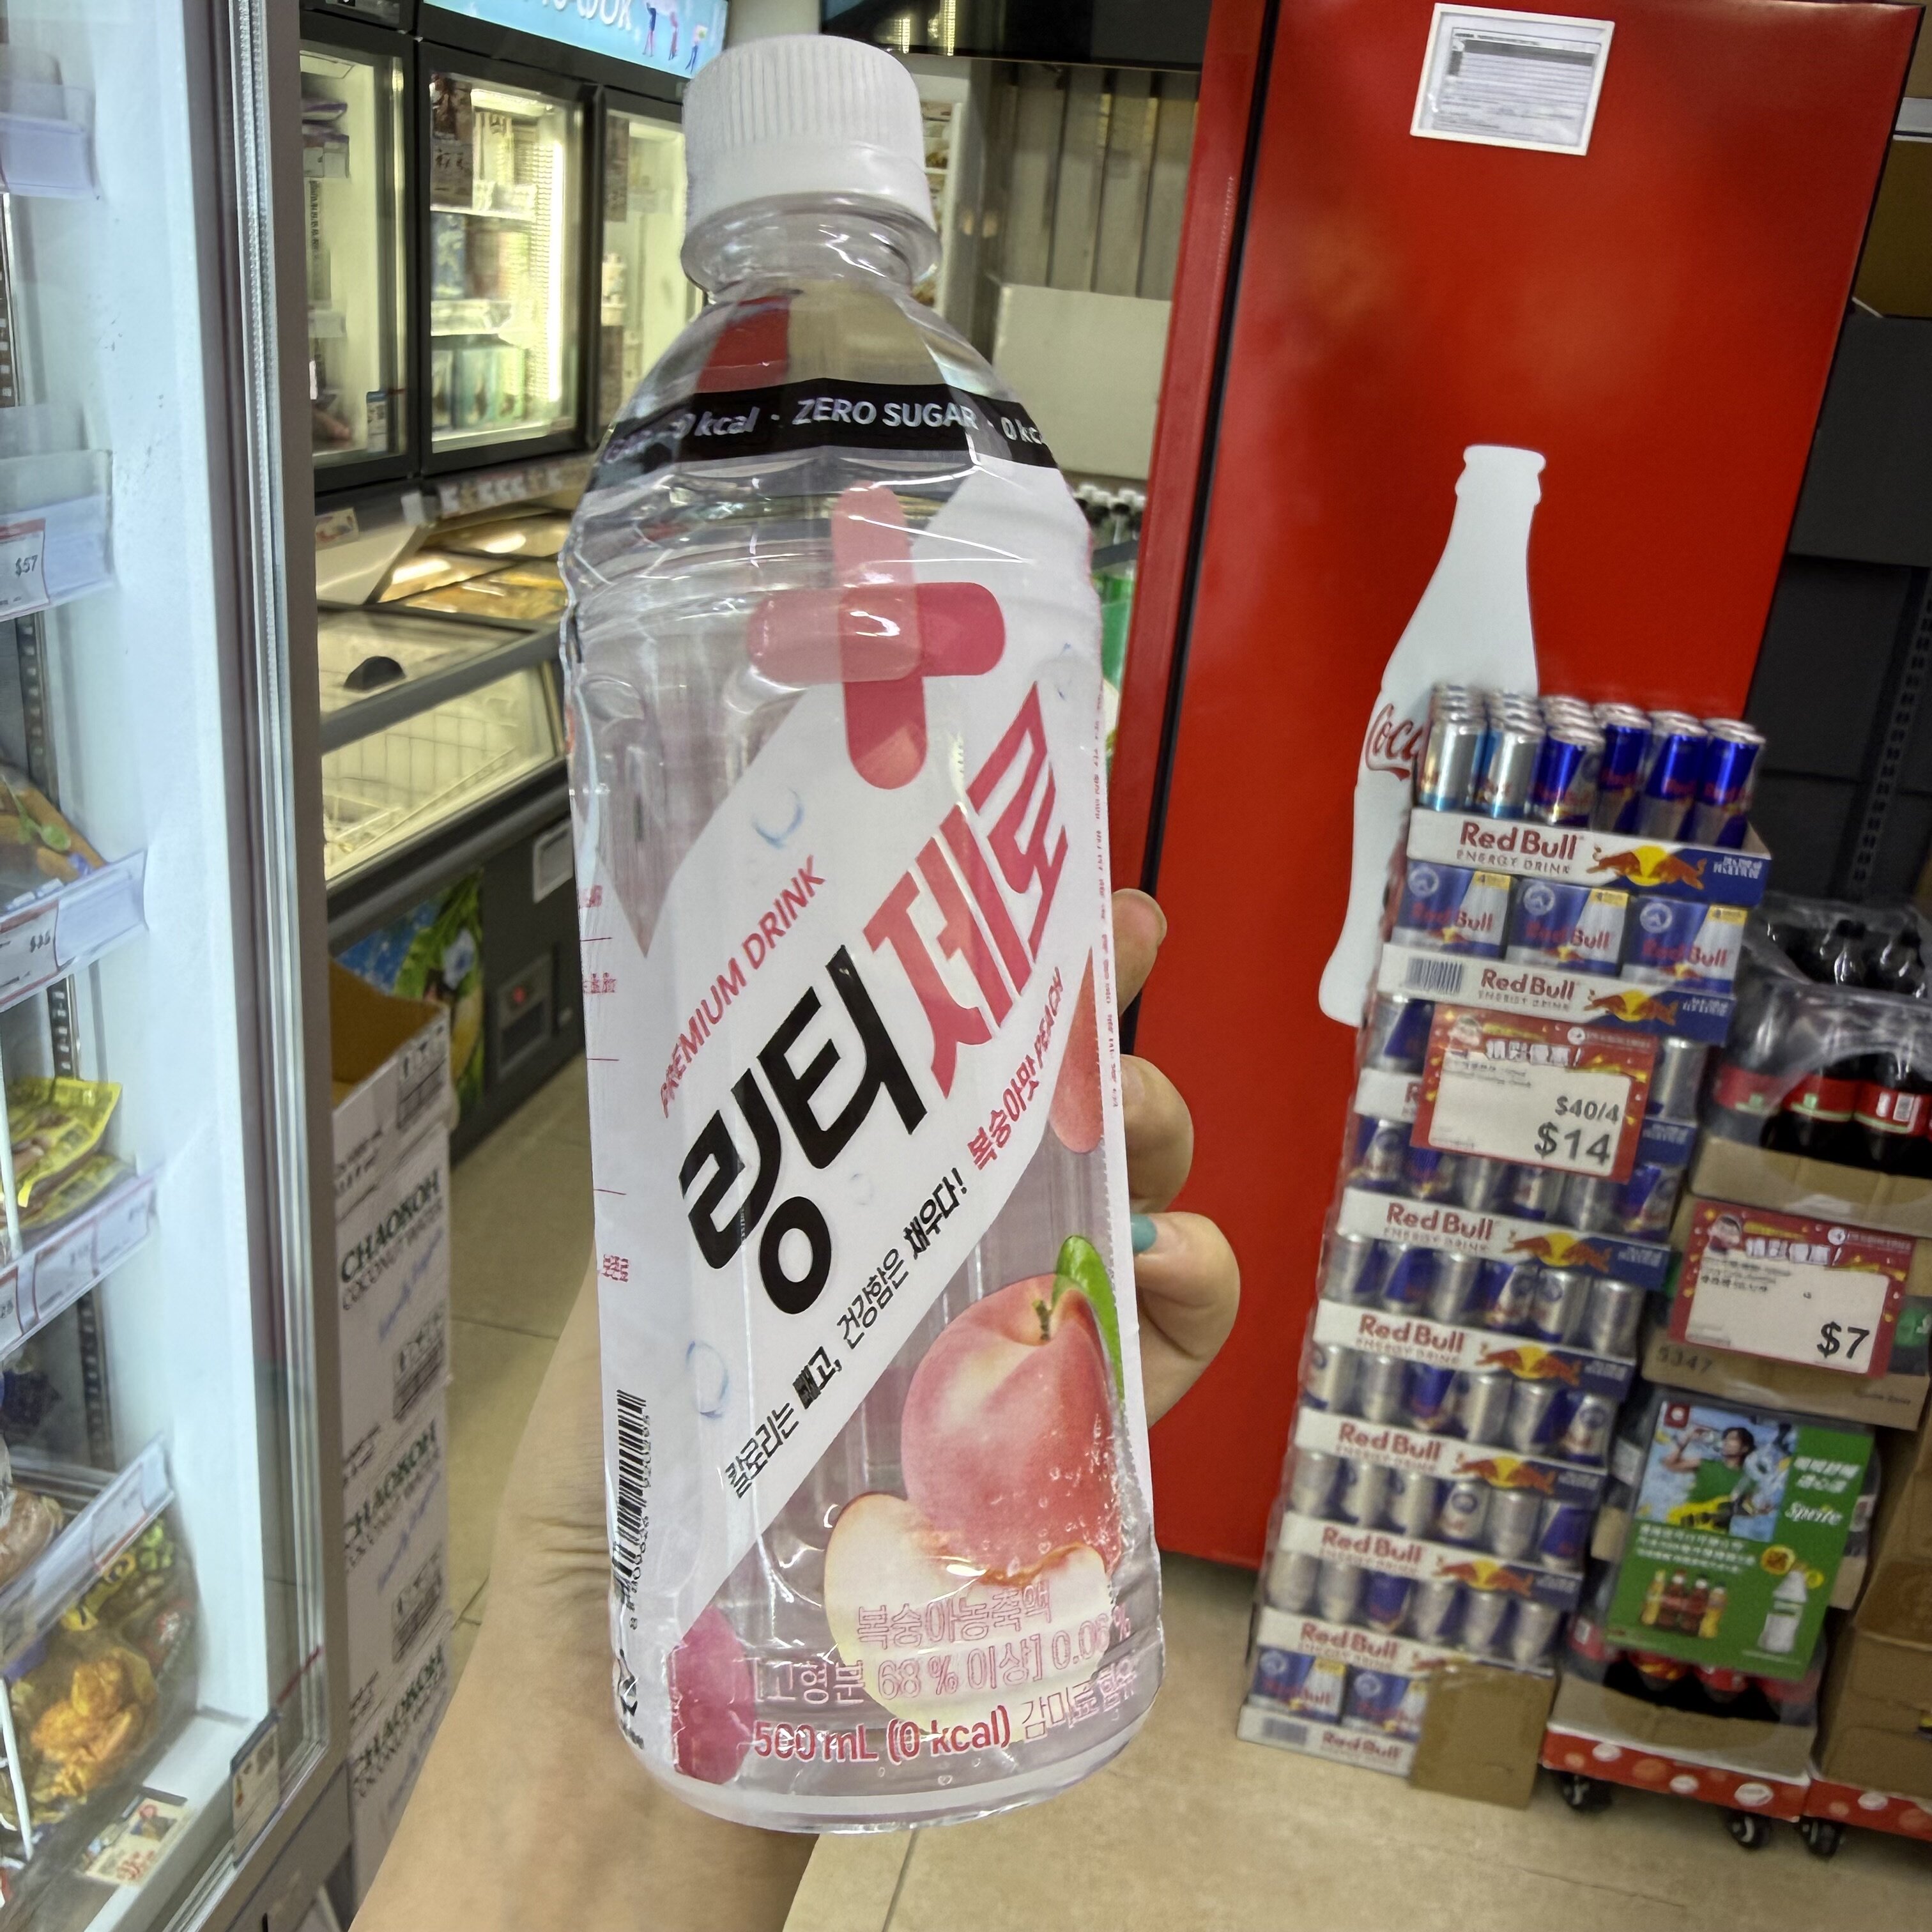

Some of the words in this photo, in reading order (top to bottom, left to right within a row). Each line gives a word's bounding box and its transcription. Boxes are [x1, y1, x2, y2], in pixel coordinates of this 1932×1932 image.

[694, 406, 760, 436] kcal
[792, 397, 877, 425] ZERO
[882, 402, 979, 431] SUGAR
[1000, 417, 1016, 441] 0
[1018, 419, 1043, 445] kc
[15, 555, 38, 577] $57
[1460, 822, 1518, 851] Red
[1521, 831, 1577, 860] Bull
[1524, 860, 1570, 875] DRINK
[1456, 911, 1493, 931] Bull
[1570, 930, 1610, 951] Bull
[1690, 946, 1728, 967] Bull
[661, 958, 747, 1118] PREMIUM
[742, 854, 825, 969] DRINK
[1481, 968, 1528, 993] Red
[1529, 976, 1575, 1000] Bull
[967, 1054, 1039, 1170] 복숭아맛
[1554, 1095, 1620, 1124] $40/4
[1534, 1121, 1611, 1166] $14
[341, 1166, 440, 1283] CHAOKOH
[1386, 1202, 1438, 1230] Red
[1443, 1212, 1493, 1241] Bull
[725, 1402, 799, 1498] 칼로리는
[837, 1248, 908, 1349] 건강함은
[903, 1167, 967, 1260] 채우다!
[1358, 1314, 1411, 1342] Red
[1413, 1324, 1464, 1353] Bull
[1816, 1321, 1870, 1360] $7
[1338, 1422, 1389, 1449] Red
[1392, 1434, 1441, 1462] Bull
[1322, 1526, 1369, 1553] Red
[1374, 1536, 1422, 1563] Bull
[857, 1580, 1052, 1650] 복숭아농축액
[1300, 1620, 1347, 1648] Red
[1351, 1633, 1399, 1660] Bull
[967, 1633, 1043, 1690] 이상]
[886, 1718, 920, 1765] (0
[930, 1705, 1011, 1757] kcal)
